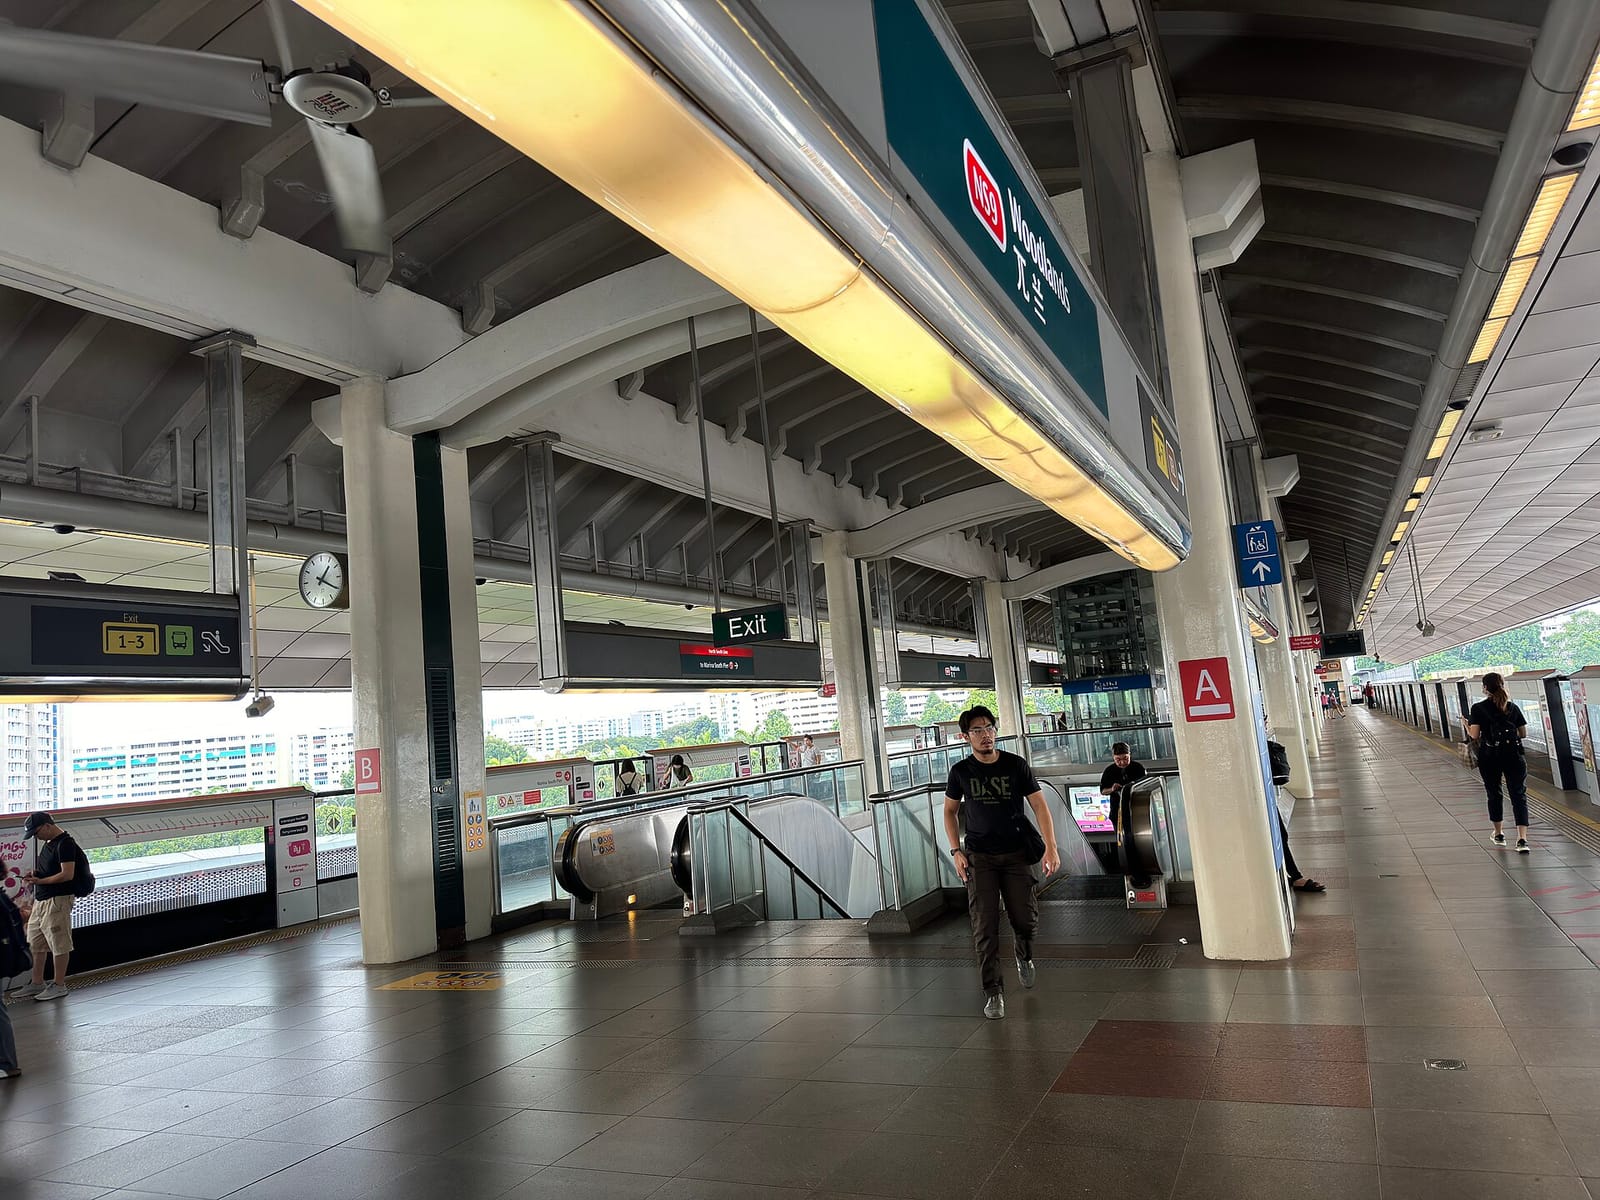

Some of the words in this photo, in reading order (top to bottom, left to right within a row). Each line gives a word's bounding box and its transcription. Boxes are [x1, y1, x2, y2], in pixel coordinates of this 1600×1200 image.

[973, 165, 999, 226] NS9
[1007, 187, 1071, 314] Woodlands
[1013, 244, 1046, 326] 兀兰
[123, 613, 138, 623] Exit
[728, 614, 768, 639] Exit
[118, 635, 145, 649] 1-3
[1195, 669, 1221, 700] A
[361, 757, 373, 779] B
